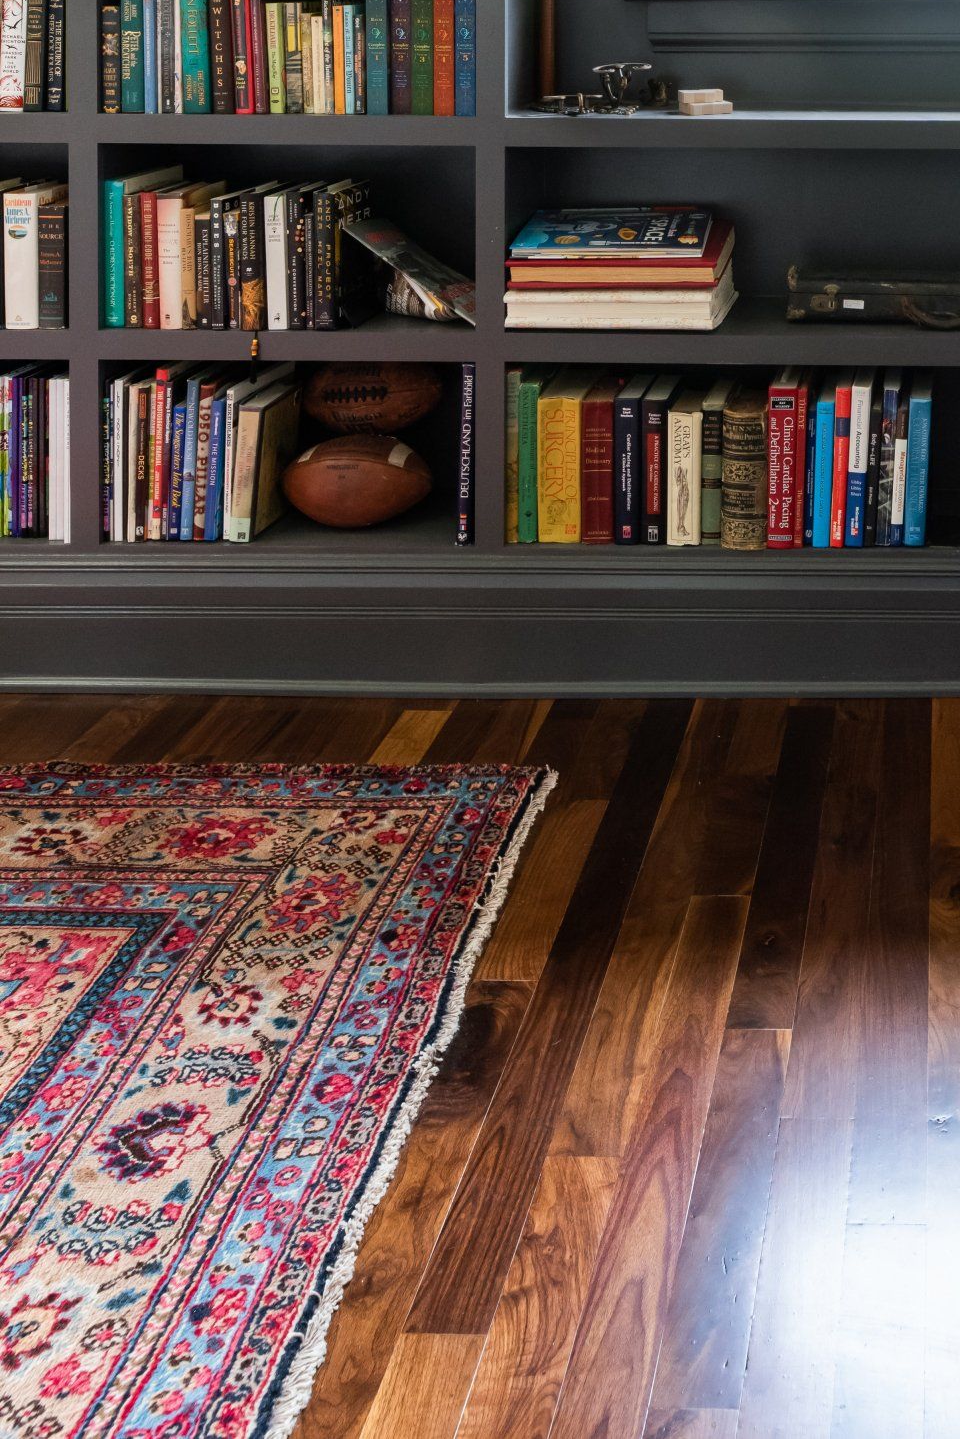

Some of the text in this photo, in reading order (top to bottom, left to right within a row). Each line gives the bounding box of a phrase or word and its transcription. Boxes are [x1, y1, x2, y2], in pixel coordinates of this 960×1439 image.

[130, 31, 141, 51] PETER
[187, 9, 199, 54] FOLLETT
[212, 6, 224, 87] WITCHES
[269, 22, 277, 50] KILDARE
[55, 66, 62, 77] OF
[122, 30, 131, 80] STARCATCHERS
[346, 51, 354, 94] Little Women
[5, 198, 32, 206] Caribbean
[7, 208, 24, 216] James
[144, 200, 153, 212] THE
[144, 214, 153, 223] DA
[337, 187, 370, 210] ANDY
[337, 206, 371, 230] WEIR
[5, 216, 32, 224] Michener
[144, 225, 153, 242] VINCI
[241, 201, 249, 260] THE FOUR WINDS
[248, 201, 256, 260] KRISTIN HANNAH
[644, 219, 669, 242] SPACE
[144, 244, 153, 261] CODE
[145, 266, 153, 279] DAN
[202, 229, 210, 304] EXPLAINING HITLER
[156, 402, 164, 443] PHOTOGRAPHER'S
[186, 402, 196, 461] NEW OLD HOUSE
[459, 375, 474, 499] DEUTSCHLAND im Farbbild
[674, 417, 682, 466] ANATOMY
[683, 425, 691, 459] GRAY'S
[853, 400, 864, 469] Financial Accounting
[155, 445, 163, 466] MANUAL
[171, 413, 184, 508] The Songwriters Idea Book
[194, 405, 211, 515] 1950 PILLAR
[209, 457, 217, 486] MISSION
[544, 408, 565, 500] SURGERY
[565, 409, 578, 503] PRINCIPLES OF
[769, 432, 781, 494] Defibrillation
[780, 417, 795, 528] Clinical Cardiac Pacing
